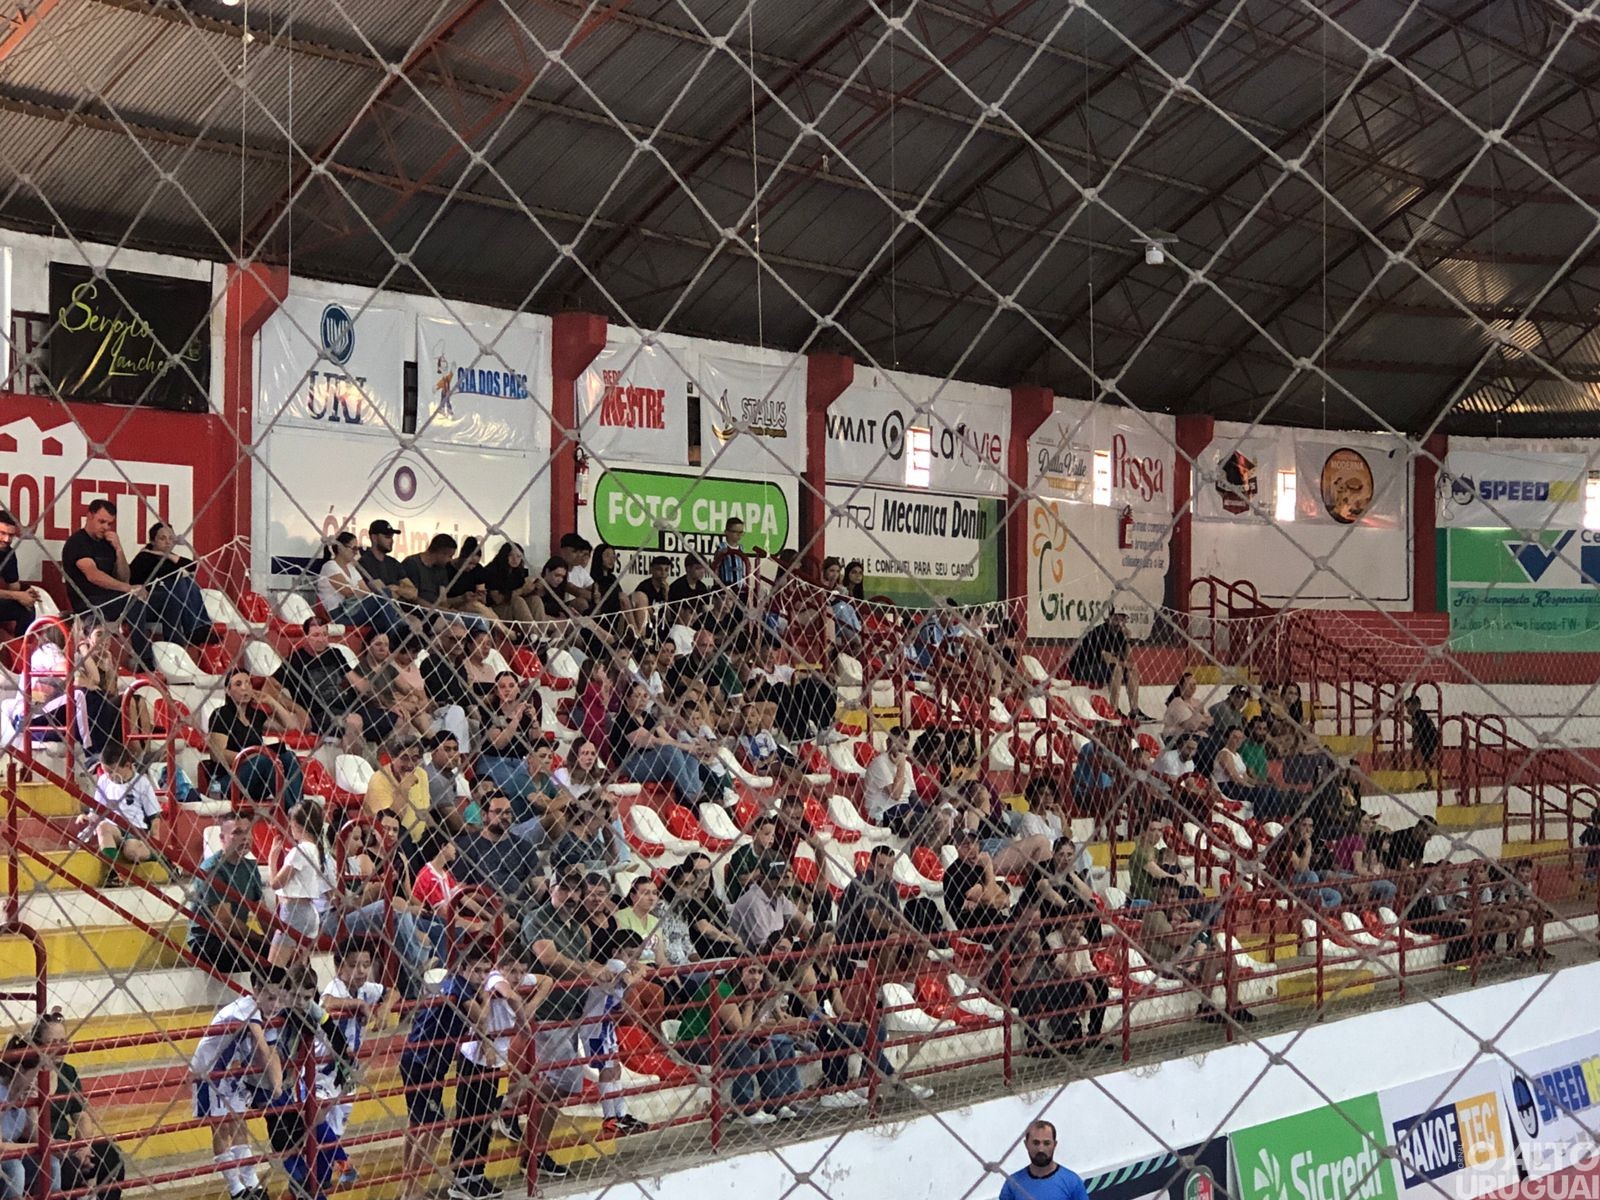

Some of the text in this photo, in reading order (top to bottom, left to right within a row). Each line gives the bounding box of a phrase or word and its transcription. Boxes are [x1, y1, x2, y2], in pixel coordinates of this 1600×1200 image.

[457, 366, 477, 393] CIA
[479, 369, 501, 397] DOS
[600, 386, 665, 430] MESTRE
[1112, 433, 1164, 502] Prosa
[0, 473, 170, 545] OLETTI
[1479, 480, 1550, 502] SPEED
[607, 491, 779, 537] FOTO CHAPA
[881, 498, 948, 538] Mecanica
[951, 501, 988, 541] Donin
[663, 532, 728, 555] DIGITA
[914, 560, 932, 577] PARA
[935, 561, 948, 577] SEU
[951, 563, 976, 579] CARRO
[1396, 1112, 1458, 1180] BAKOF
[1460, 1102, 1496, 1153] TEC
[1290, 1130, 1383, 1200] Sicredi
